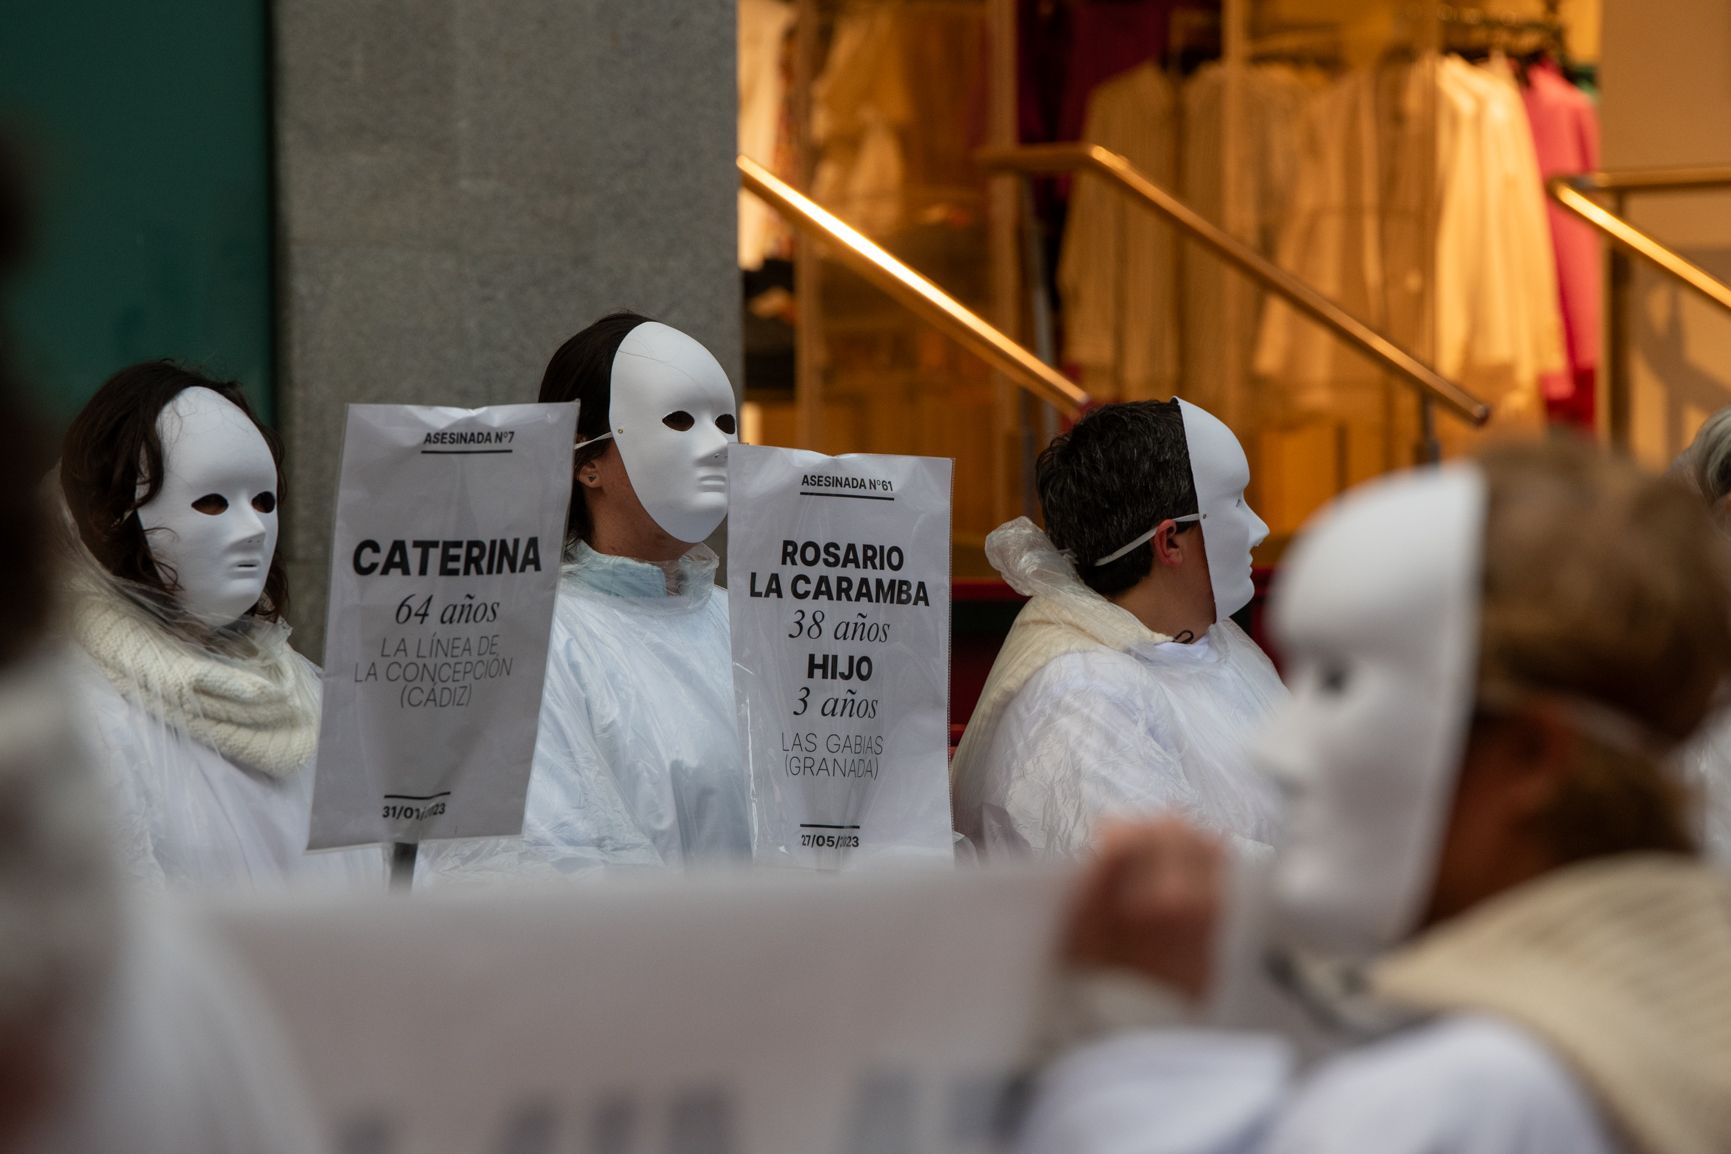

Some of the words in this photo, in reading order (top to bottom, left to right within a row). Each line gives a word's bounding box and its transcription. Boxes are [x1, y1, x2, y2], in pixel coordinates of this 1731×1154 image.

[423, 432, 492, 445] ASESINADA
[801, 474, 867, 490] ASESINADA
[869, 478, 893, 492] Nº61
[352, 536, 542, 577] CATERINA
[781, 539, 904, 572] ROSARIO
[750, 571, 783, 599] LA
[790, 573, 930, 607] CARAMBA
[395, 593, 433, 625] 64
[440, 593, 501, 625] años
[788, 609, 825, 640] 38
[833, 612, 890, 643] años
[380, 637, 408, 658] LA
[416, 632, 472, 658] LÍNEA
[477, 634, 499, 656] DE
[353, 661, 378, 683] LA
[385, 653, 513, 683] CONCEPCIÓN
[807, 653, 873, 681] HIJO
[400, 682, 472, 708] (CÁDIZ)
[792, 686, 811, 716] 3
[821, 689, 879, 719] años
[781, 732, 818, 753] LAS
[826, 733, 884, 755] GABIAS
[784, 754, 879, 781] (GRANADA)
